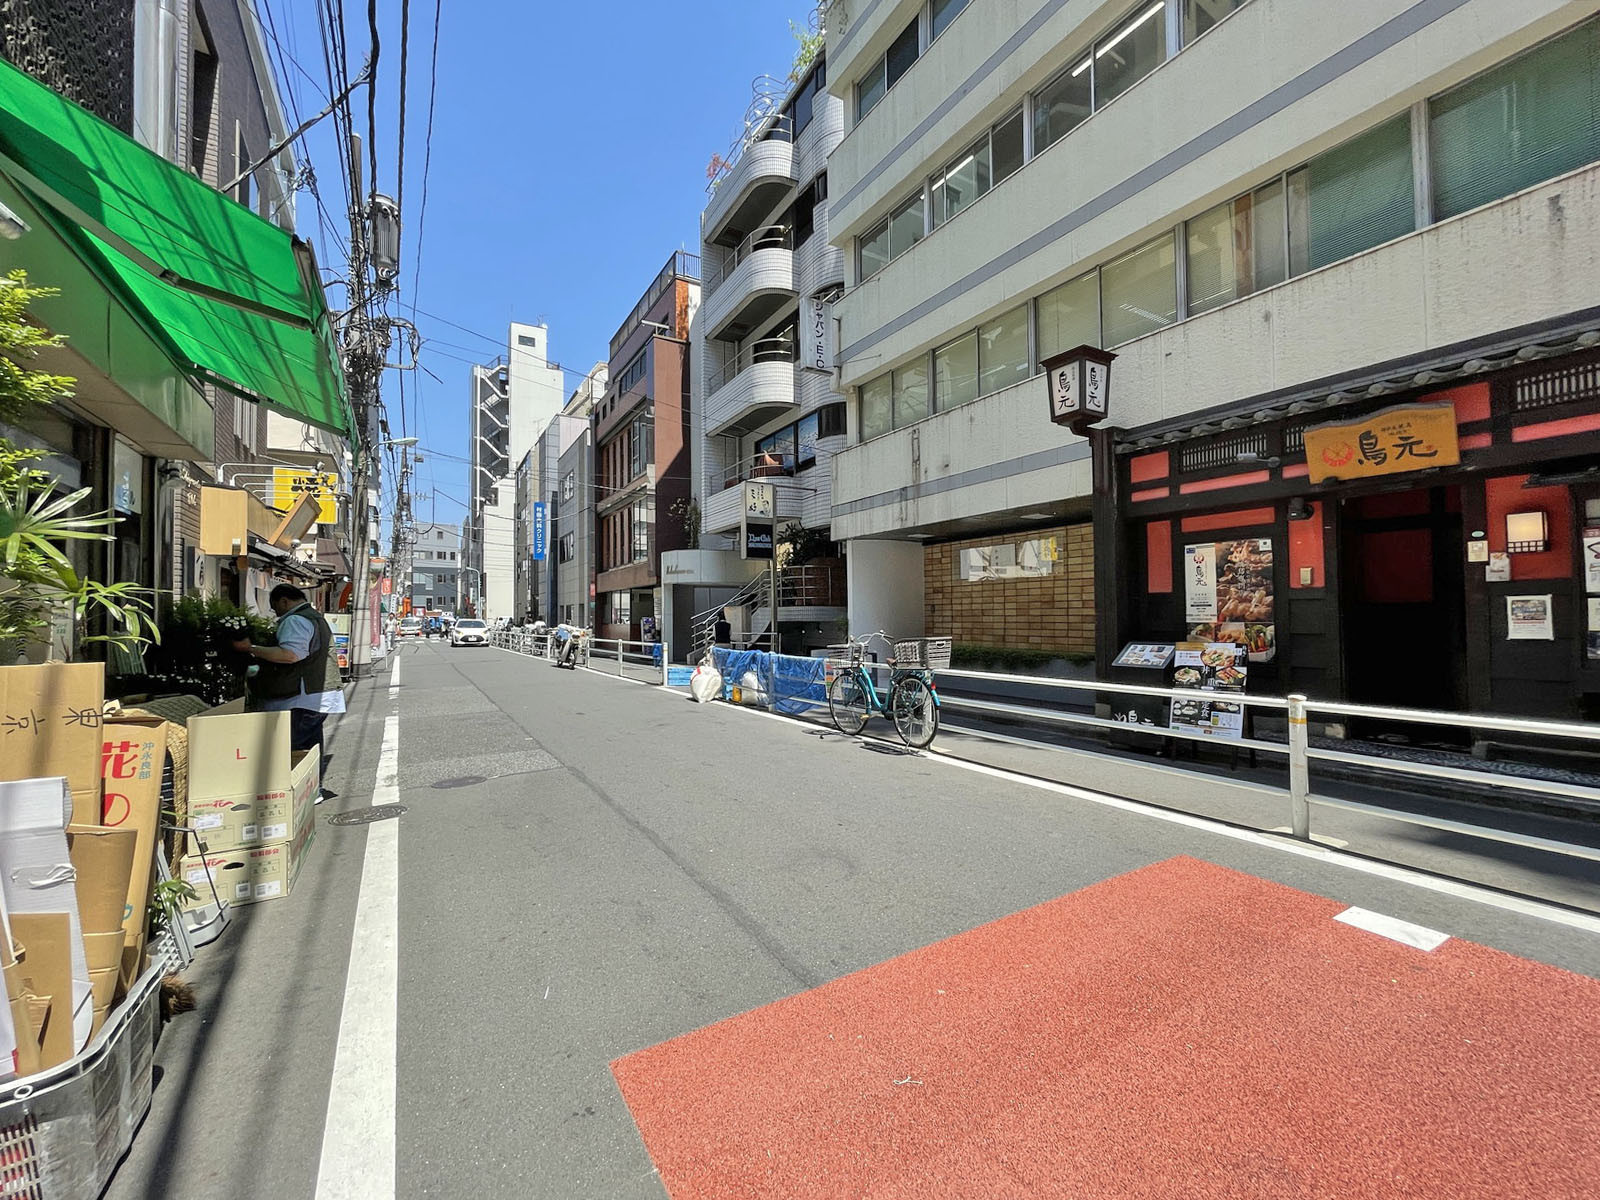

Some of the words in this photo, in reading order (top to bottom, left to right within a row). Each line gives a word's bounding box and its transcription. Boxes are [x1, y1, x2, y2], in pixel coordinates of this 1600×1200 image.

[1058, 370, 1075, 410] 鳥元
[1088, 366, 1101, 408] 鳥元
[1357, 430, 1438, 466] 鳥元
[236, 748, 247, 760] L
